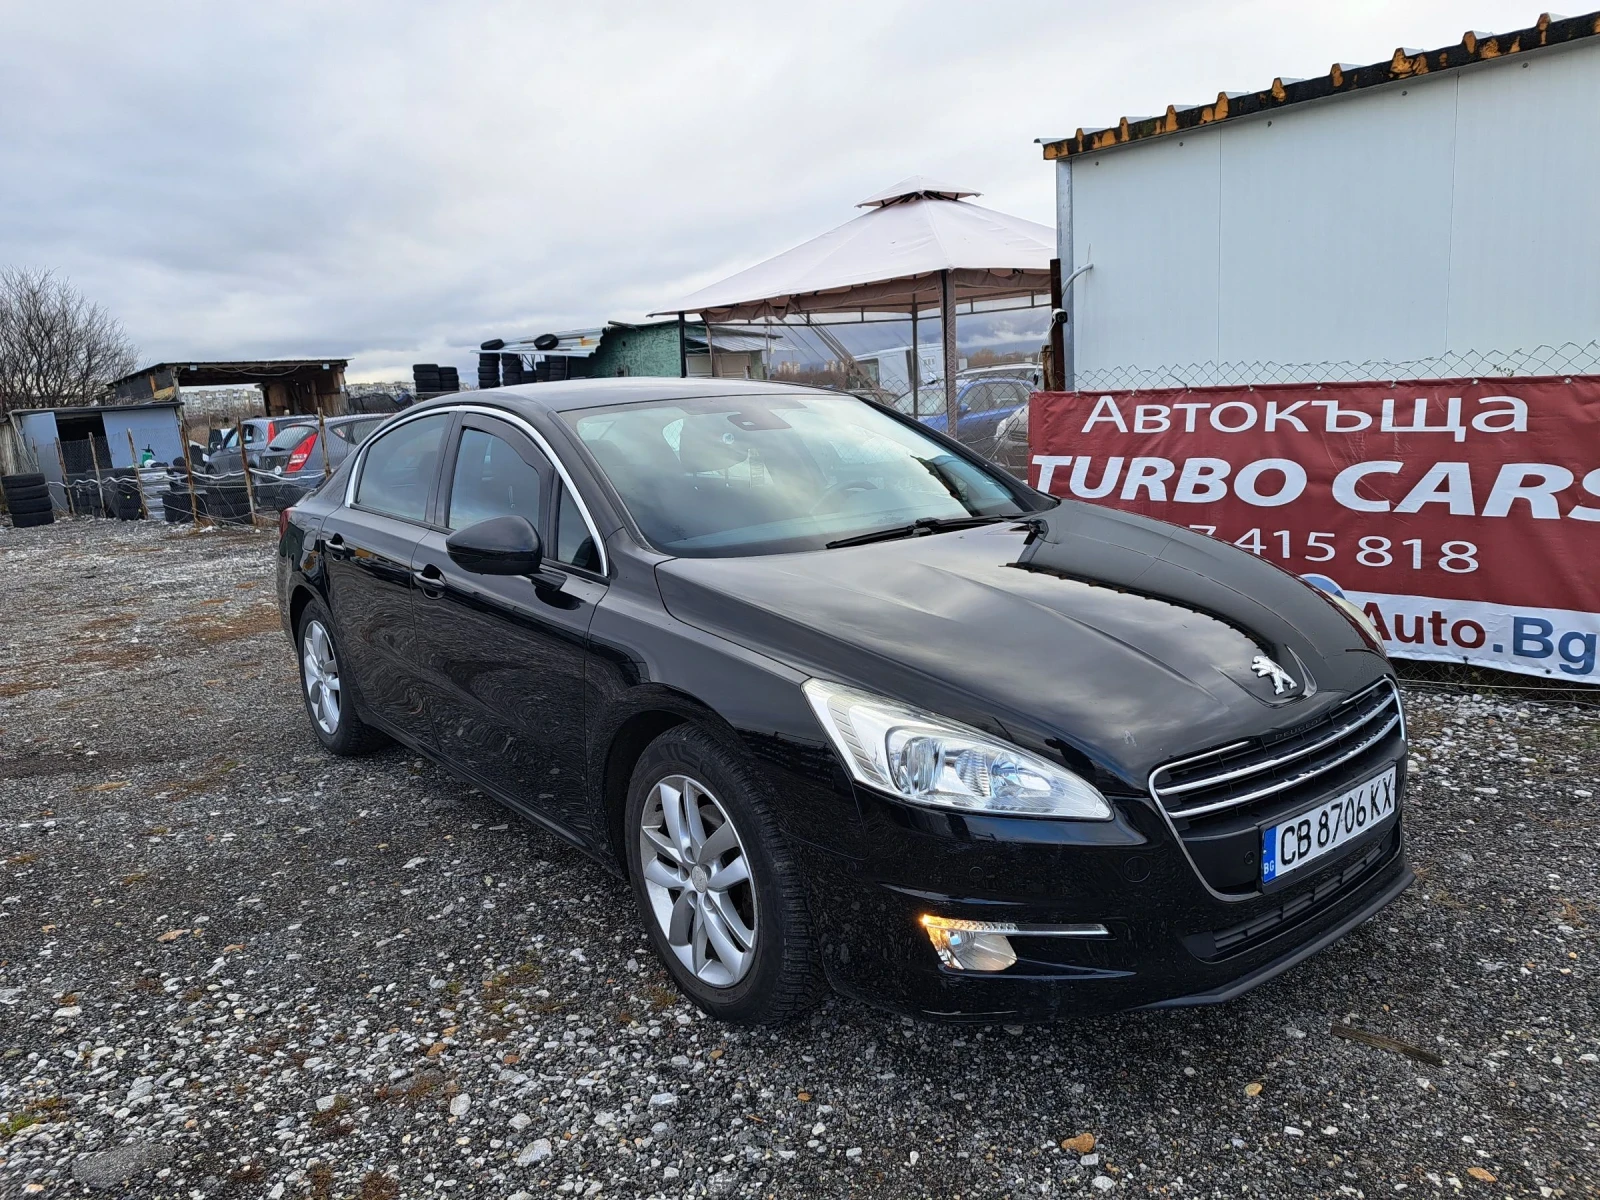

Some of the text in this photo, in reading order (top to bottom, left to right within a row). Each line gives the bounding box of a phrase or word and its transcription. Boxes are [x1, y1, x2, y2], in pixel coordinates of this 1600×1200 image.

[1081, 394, 1529, 443] Автокъща
[1031, 454, 1308, 507] TURBO
[1232, 527, 1480, 574] 415 818
[1362, 601, 1597, 676] Auto.Bg
[1316, 789, 1367, 849] 8706
[1263, 859, 1275, 875] BG
